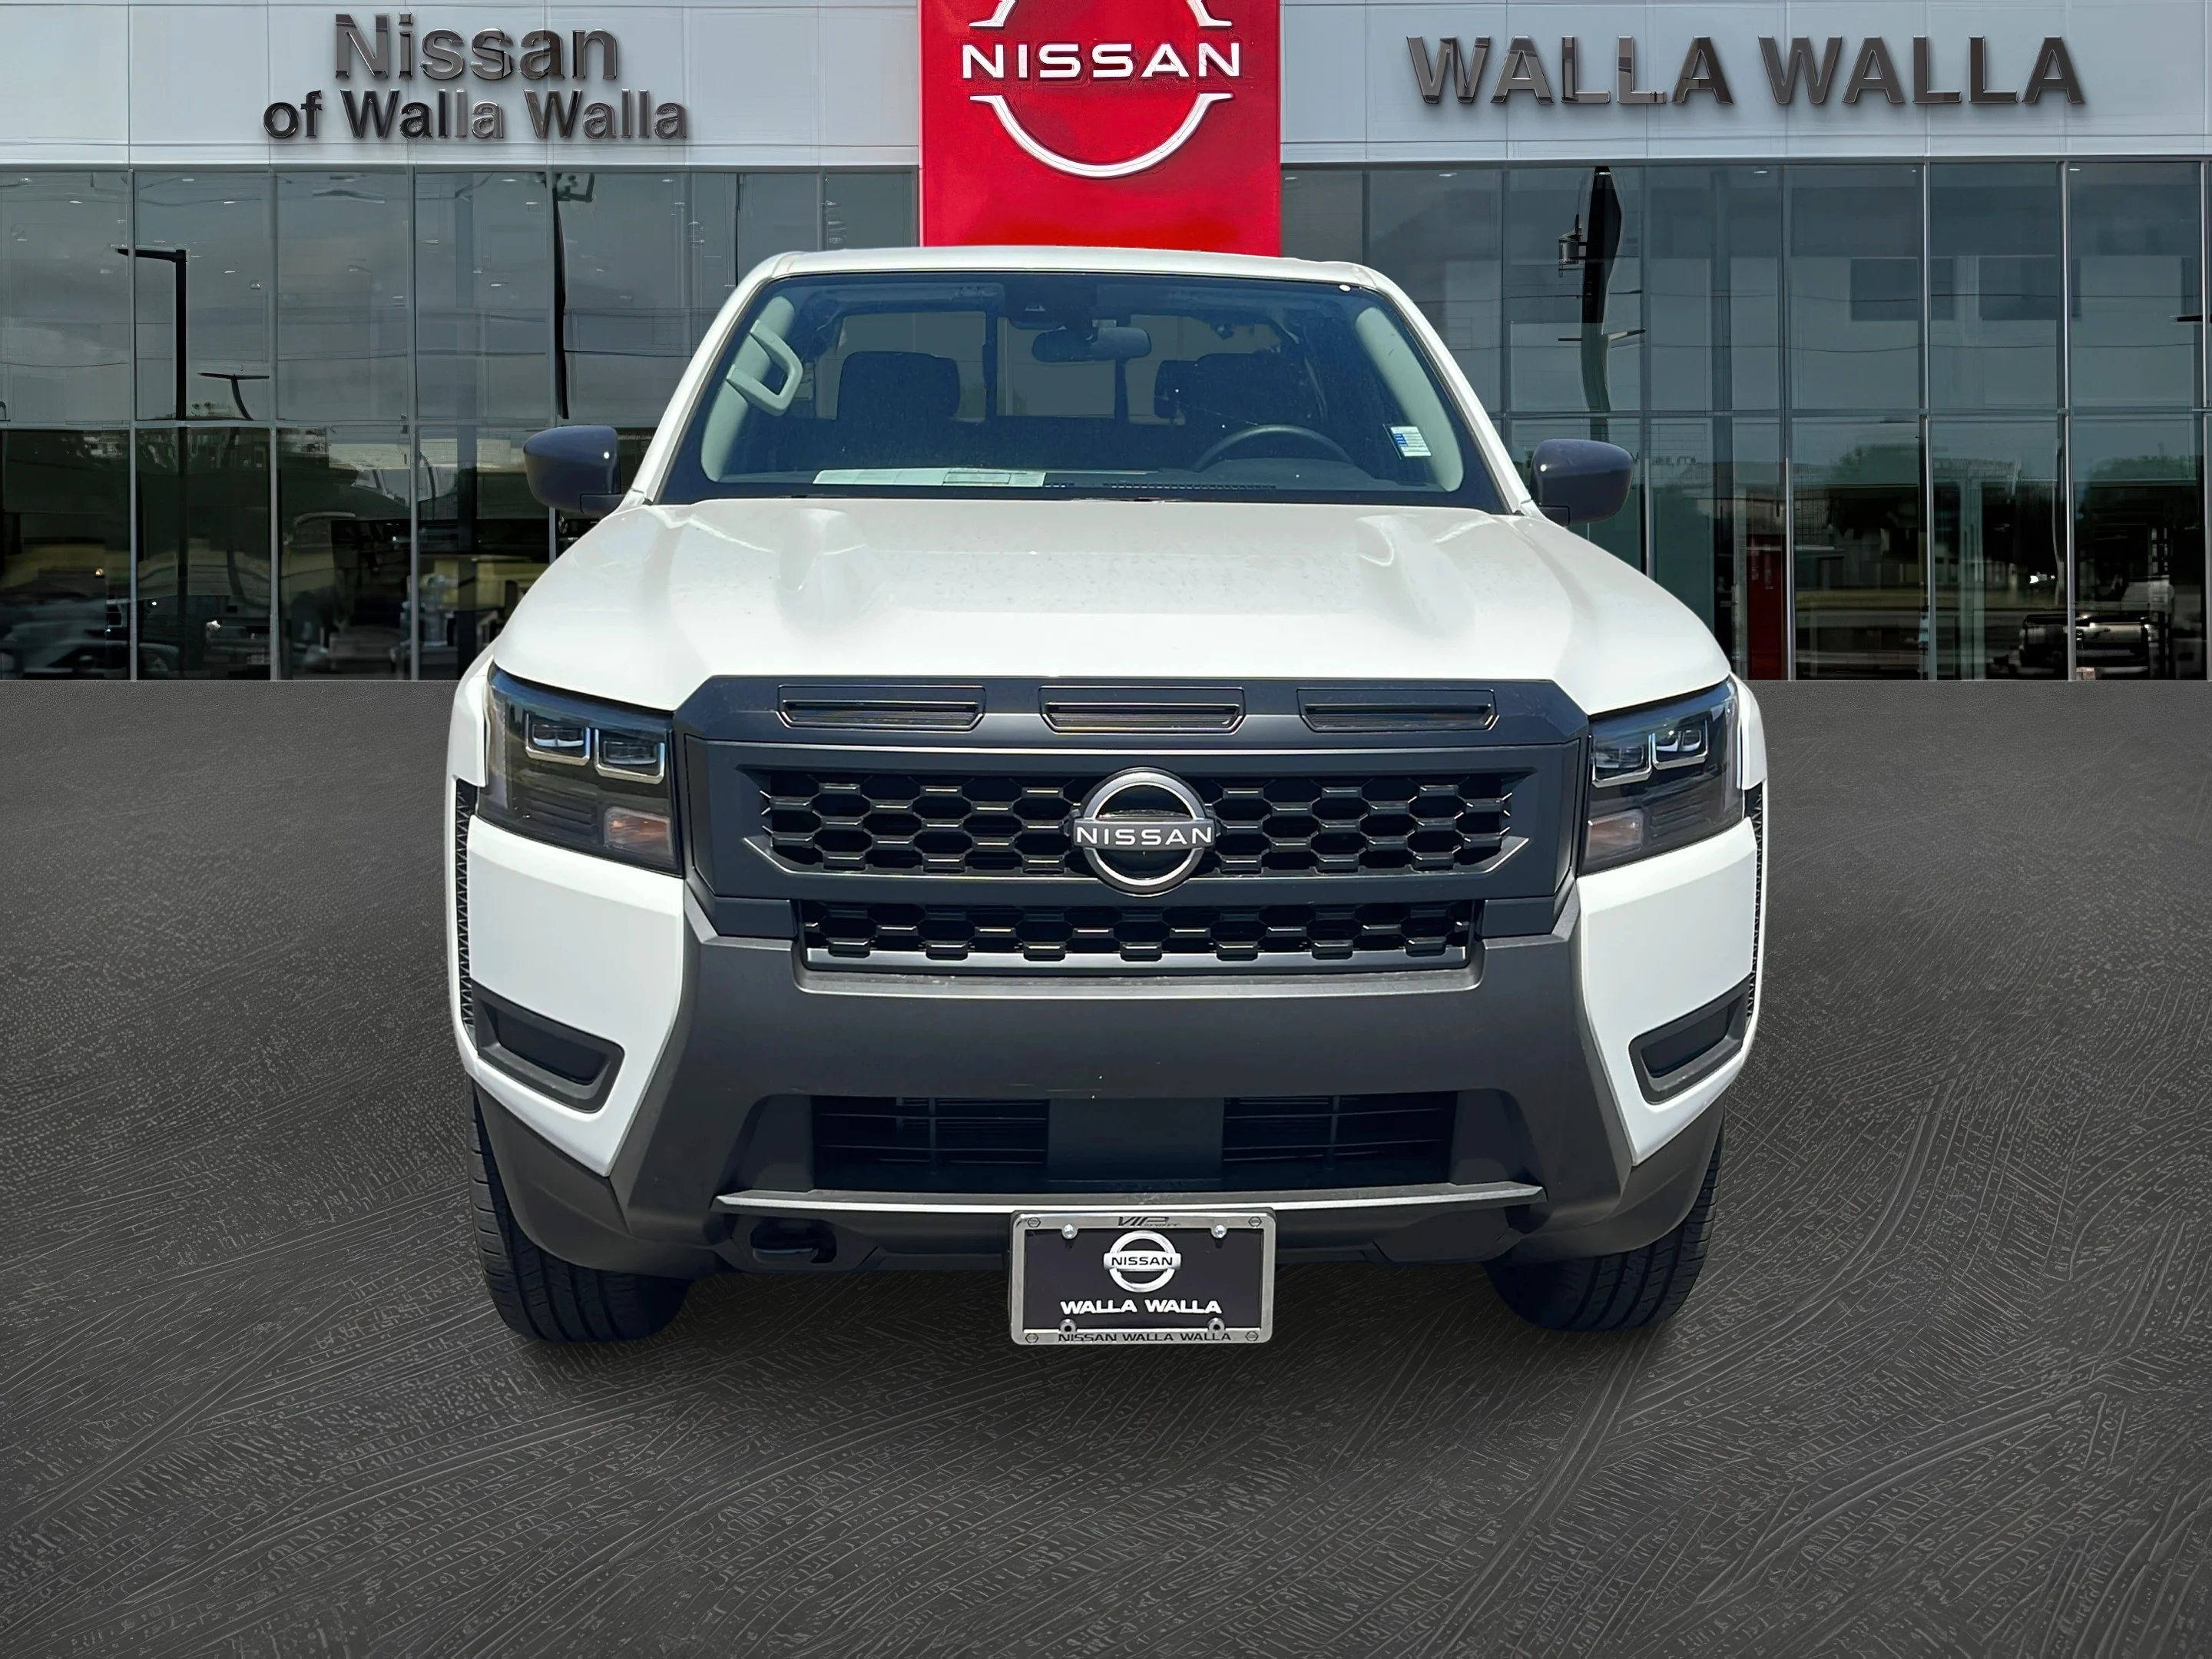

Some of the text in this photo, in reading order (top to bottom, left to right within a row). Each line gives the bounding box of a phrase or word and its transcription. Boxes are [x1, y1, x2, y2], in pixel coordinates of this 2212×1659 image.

[334, 13, 617, 80] Nissan
[962, 42, 1240, 78] NISSAN
[1406, 35, 2086, 104] WALLA WALLA
[263, 89, 687, 139] of Walla Walla
[1076, 826, 1212, 846] NISSAN
[1111, 1256, 1173, 1266] NISSAN
[1060, 1300, 1222, 1314] WALLA WALLA
[1058, 1333, 1117, 1342] NISSAN
[1180, 1332, 1231, 1341] WALLA
